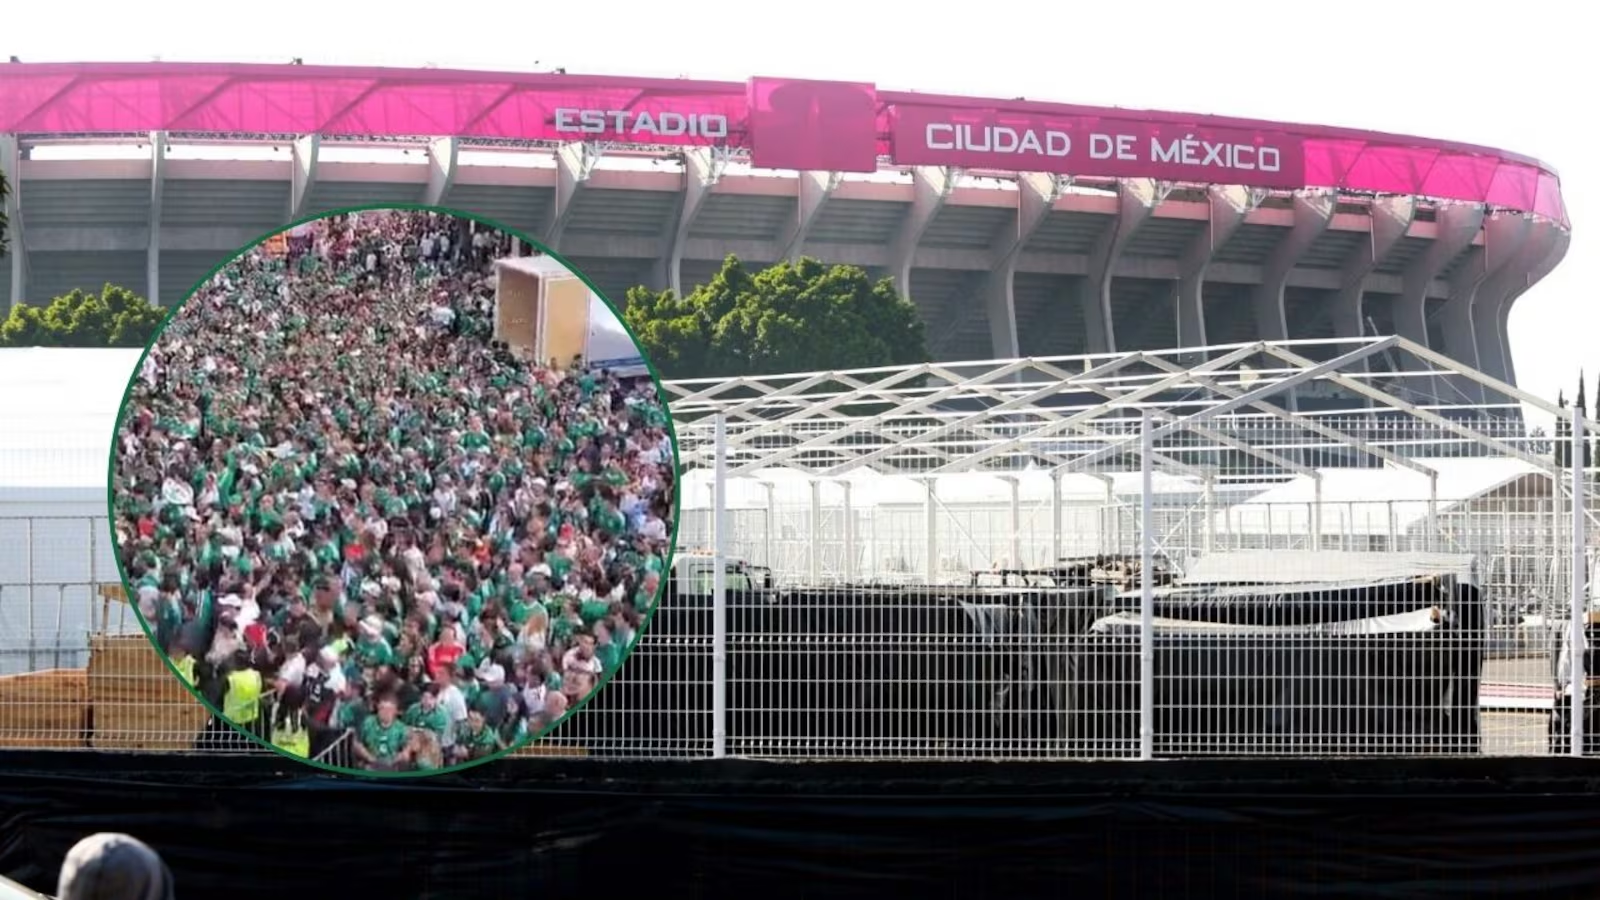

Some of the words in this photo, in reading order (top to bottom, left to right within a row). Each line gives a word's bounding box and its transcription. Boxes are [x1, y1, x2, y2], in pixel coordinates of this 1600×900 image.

[555, 107, 728, 137] ESTADIO
[925, 122, 1072, 157] CIUDAD
[1089, 133, 1138, 161] DE
[1150, 134, 1281, 172] MÉXICO
